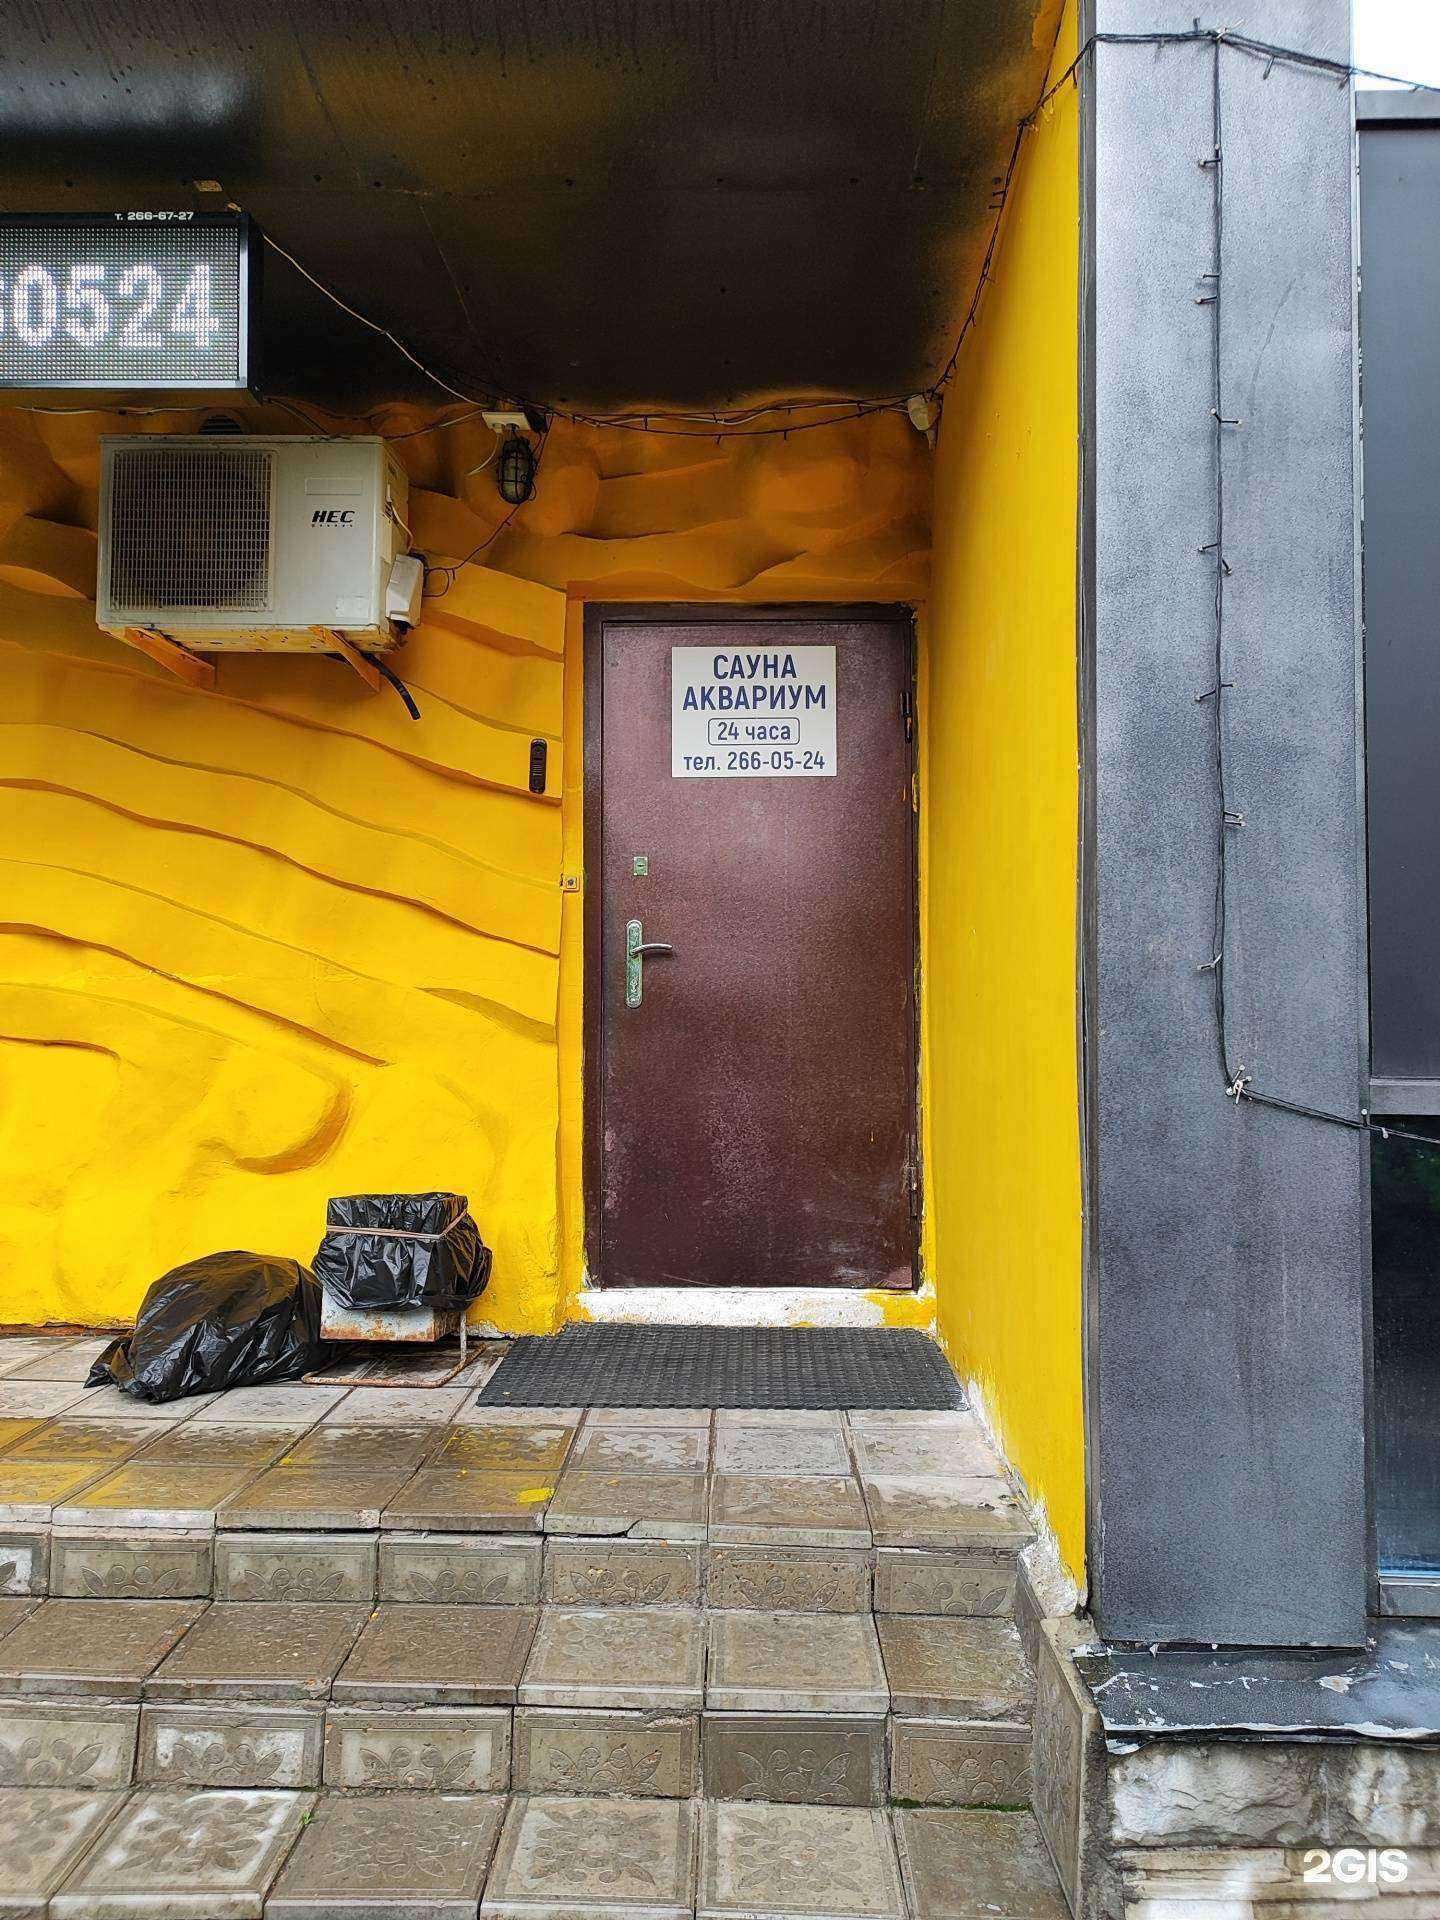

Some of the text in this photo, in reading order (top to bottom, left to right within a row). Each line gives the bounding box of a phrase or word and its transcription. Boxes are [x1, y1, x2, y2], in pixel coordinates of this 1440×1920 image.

[127, 211, 194, 221] 266-67-27
[0, 265, 219, 347] 0524
[311, 510, 355, 523] HEC
[713, 654, 797, 680] САУНА
[682, 684, 826, 711] АКВАРИУМ
[717, 721, 791, 741] 24 часа
[683, 750, 826, 771] тел. 266-05-24
